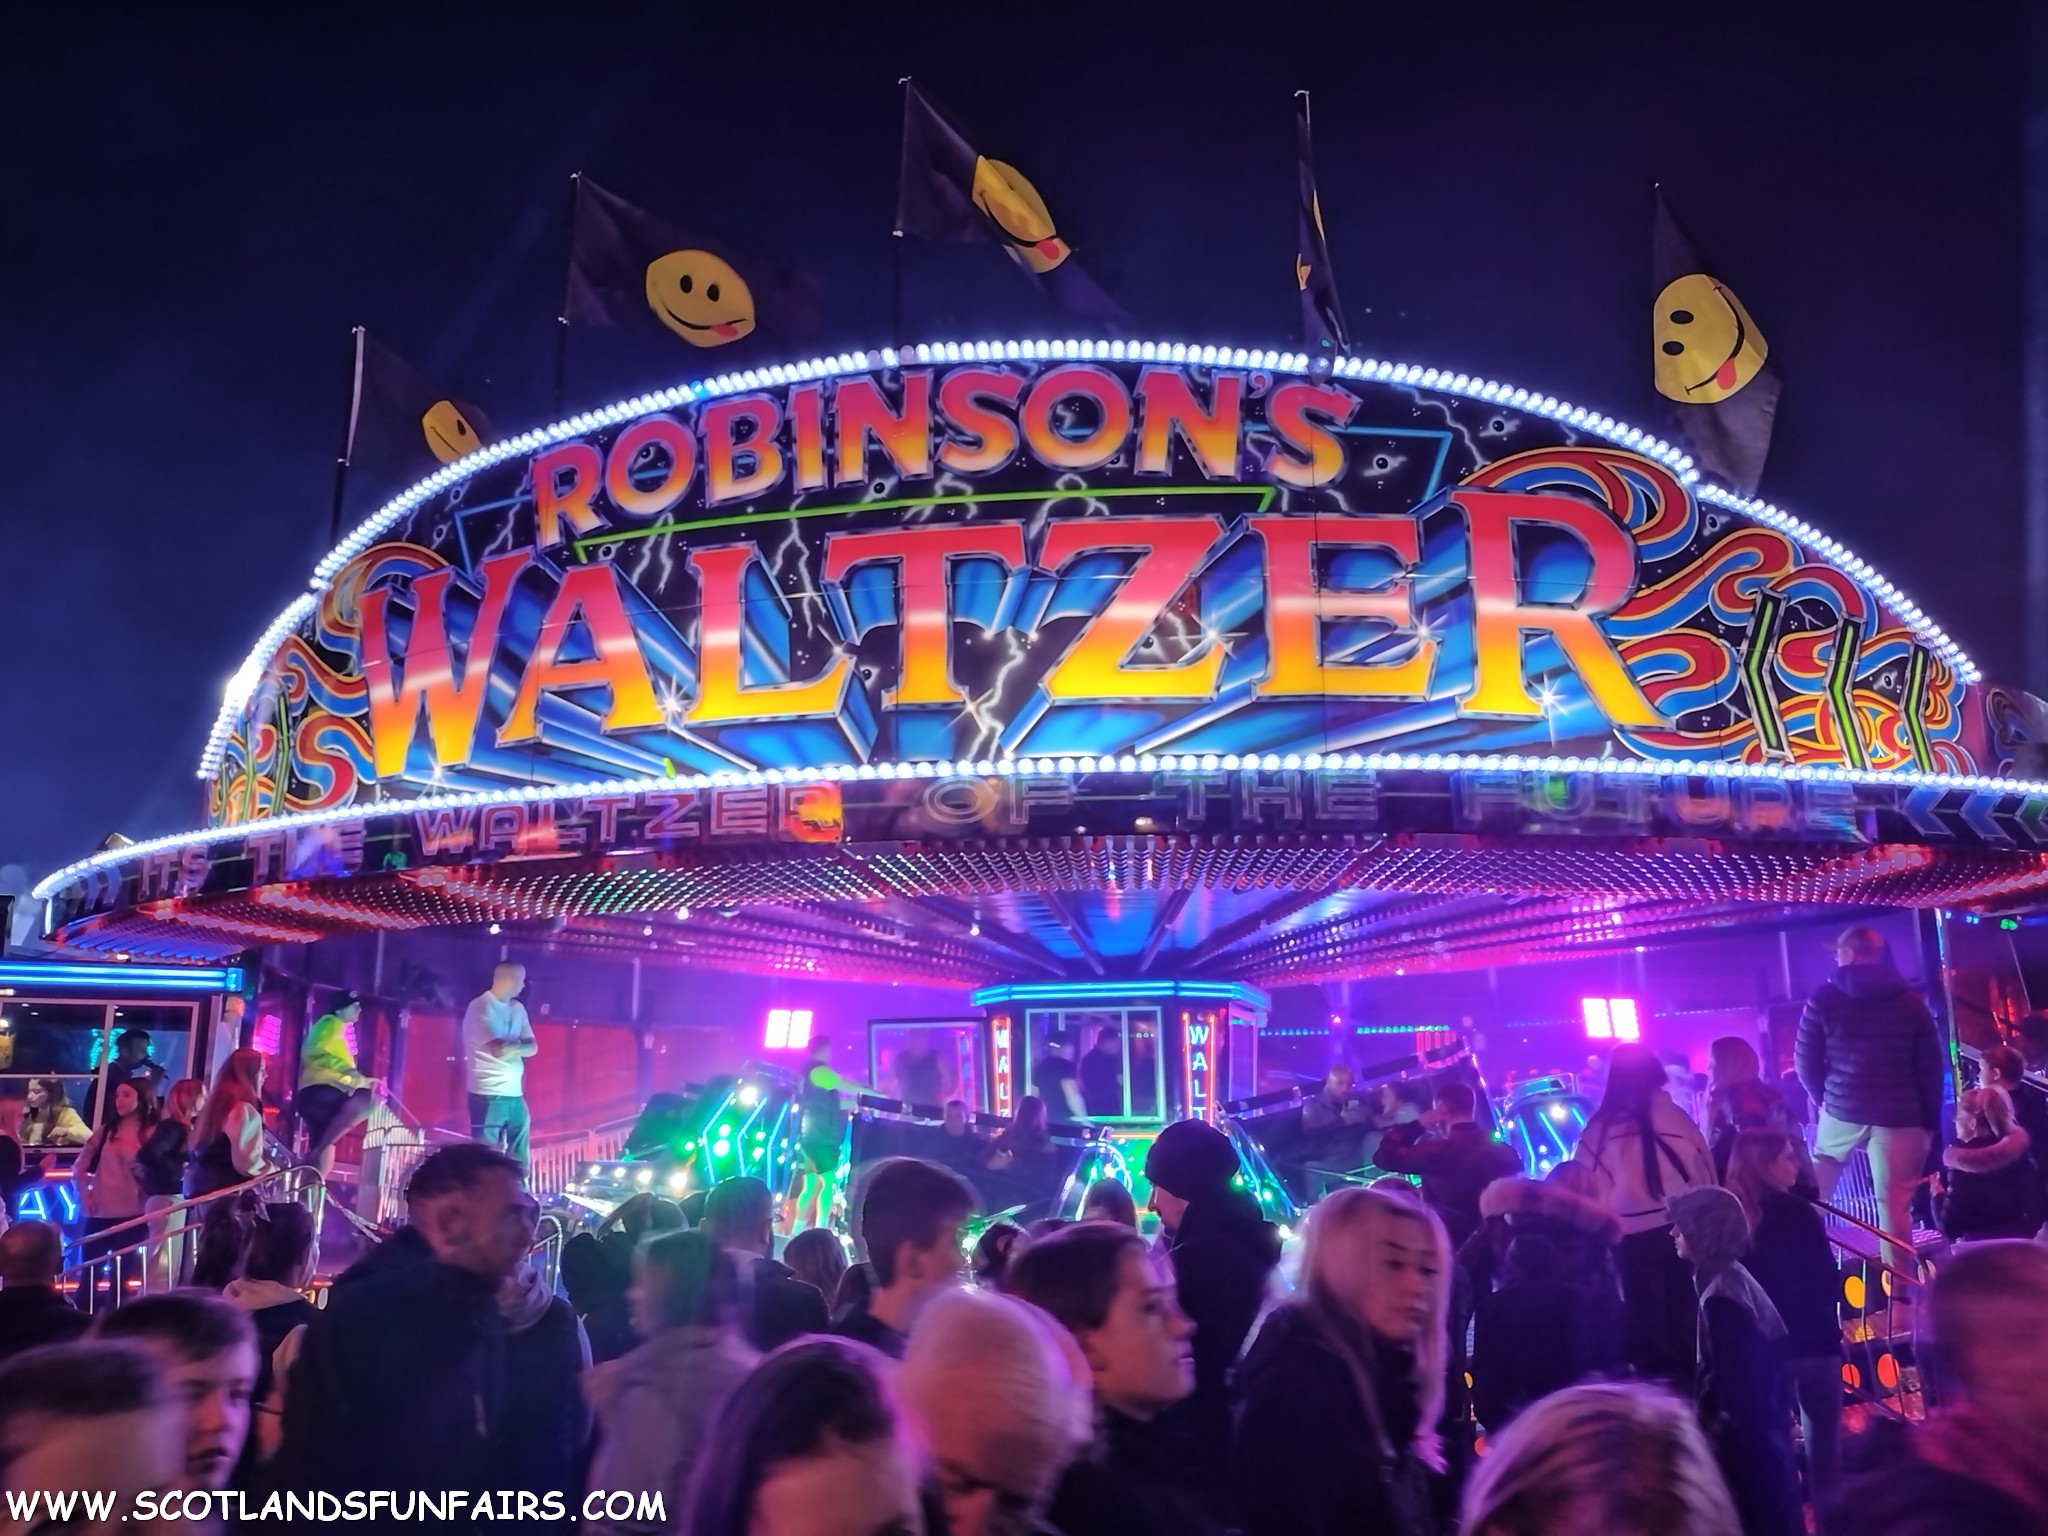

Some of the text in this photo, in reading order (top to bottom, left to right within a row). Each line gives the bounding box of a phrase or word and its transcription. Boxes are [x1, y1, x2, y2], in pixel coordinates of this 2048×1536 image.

[529, 363, 1362, 550] ROBINSON'S
[358, 484, 1677, 780] WALTZER
[922, 772, 1074, 826] OF
[1154, 768, 1379, 823] THE
